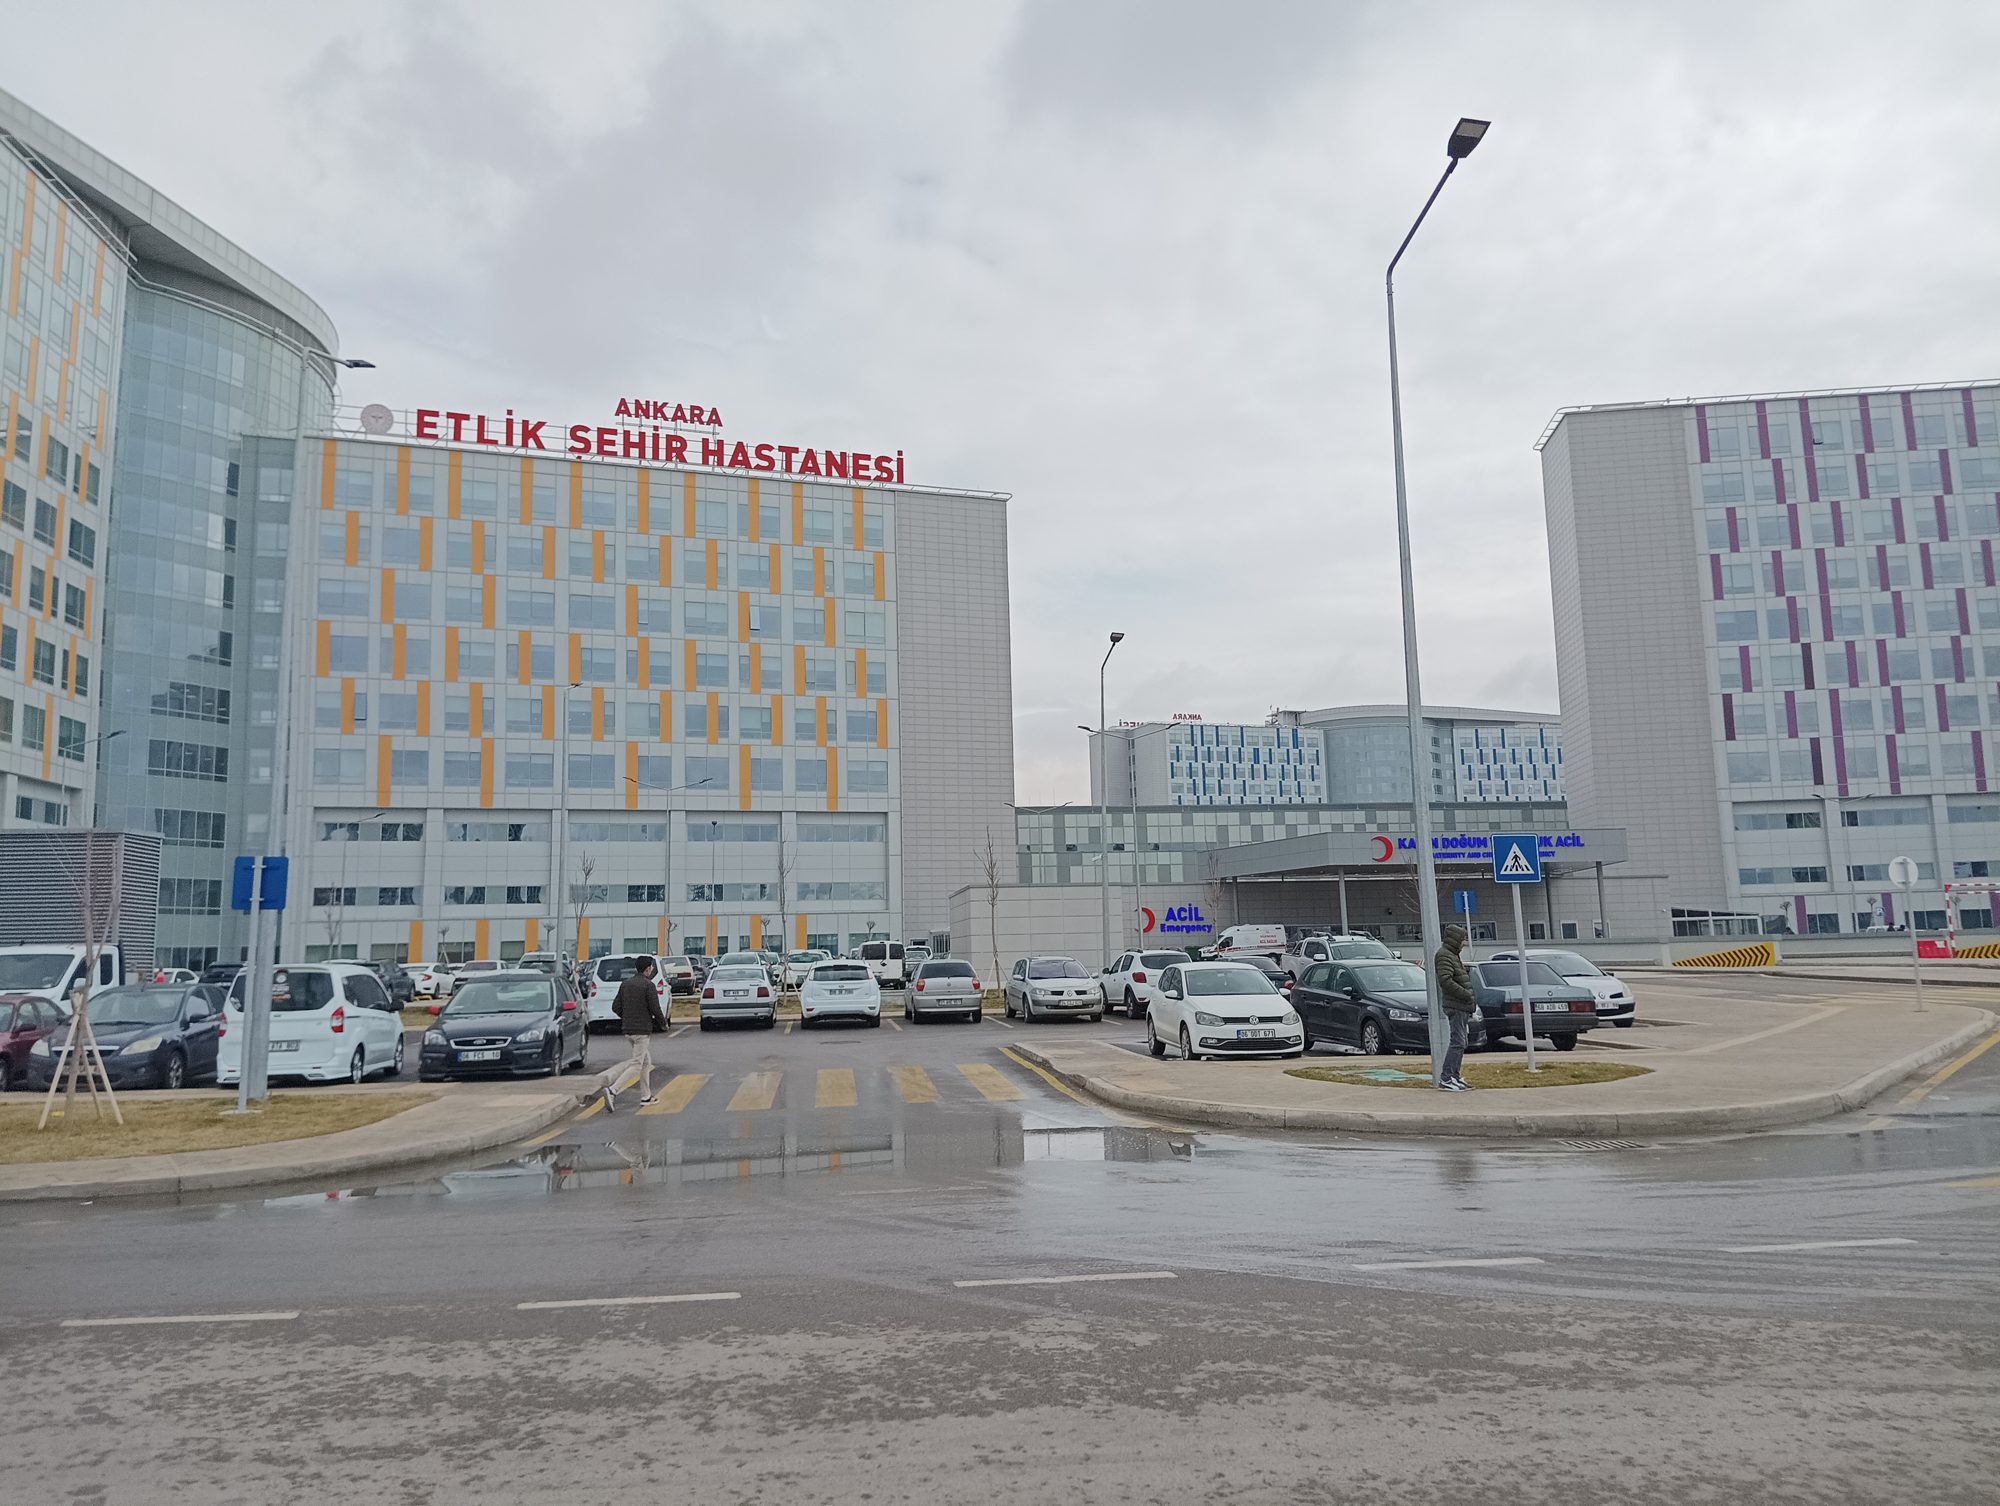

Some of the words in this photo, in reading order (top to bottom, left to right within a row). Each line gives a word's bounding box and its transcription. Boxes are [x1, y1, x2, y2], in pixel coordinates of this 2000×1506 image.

[615, 398, 723, 427] ANKARA
[416, 409, 548, 450] ETLİK
[568, 424, 688, 463] ŞEHİR
[702, 438, 904, 484] HASTANESİ
[1397, 837, 1439, 849] KAN
[1441, 833, 1488, 849] DOĞUM
[1555, 832, 1585, 847] ACİL
[1165, 903, 1205, 921] ACİL
[1160, 923, 1213, 933] Emergency
